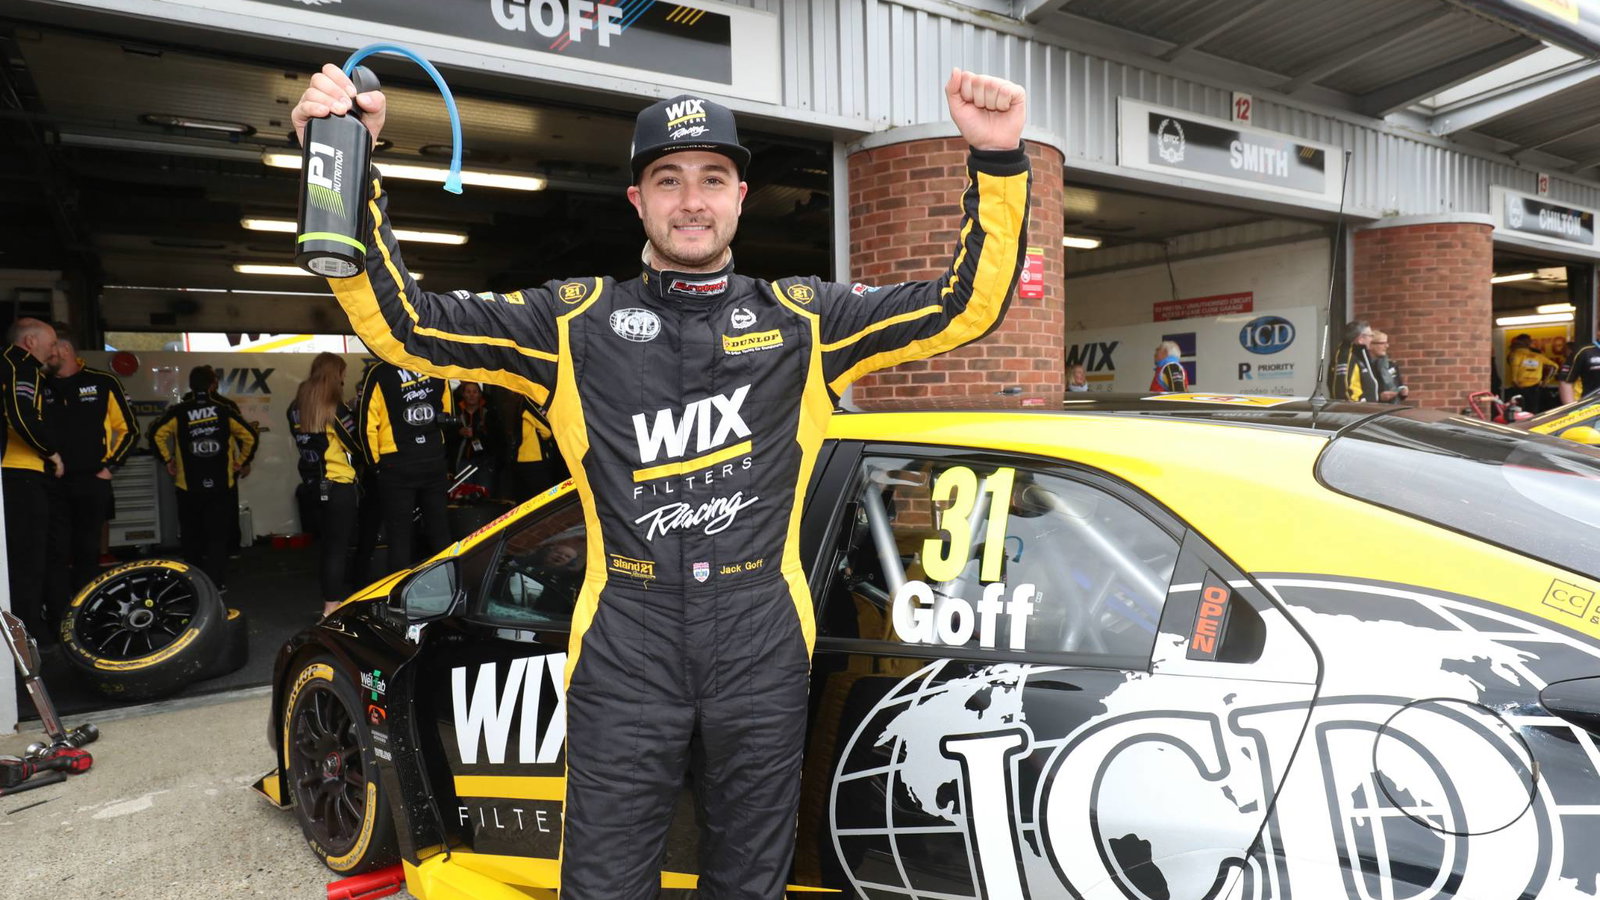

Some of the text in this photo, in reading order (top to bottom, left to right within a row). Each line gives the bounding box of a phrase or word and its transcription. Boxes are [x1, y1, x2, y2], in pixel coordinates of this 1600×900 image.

[490, 0, 623, 48] GOFF
[665, 99, 706, 121] WIX
[1235, 96, 1251, 120] 12
[669, 125, 710, 140] Racing
[308, 141, 335, 189] P1
[333, 149, 344, 194] NUTRITION
[1230, 139, 1289, 178] SMITH
[1538, 208, 1582, 237] CHILTON
[732, 334, 779, 348] DUNLOP
[1244, 323, 1293, 348] ICD
[1257, 363, 1294, 371] PRIORITY
[79, 385, 97, 394] WIX
[187, 406, 218, 421] WIX
[407, 407, 434, 421] ICD
[632, 384, 752, 463] WIX
[192, 441, 220, 453] ICD
[633, 457, 753, 500] FILTERS
[634, 491, 759, 542] Racing
[922, 466, 1016, 583] 31
[720, 564, 742, 576] Jack
[745, 558, 764, 571] Goff
[1551, 588, 1586, 608] CC
[892, 580, 1036, 650] Goff
[1191, 586, 1228, 654] OPEN
[942, 694, 1556, 900] ICD
[458, 806, 564, 833] FILTE
